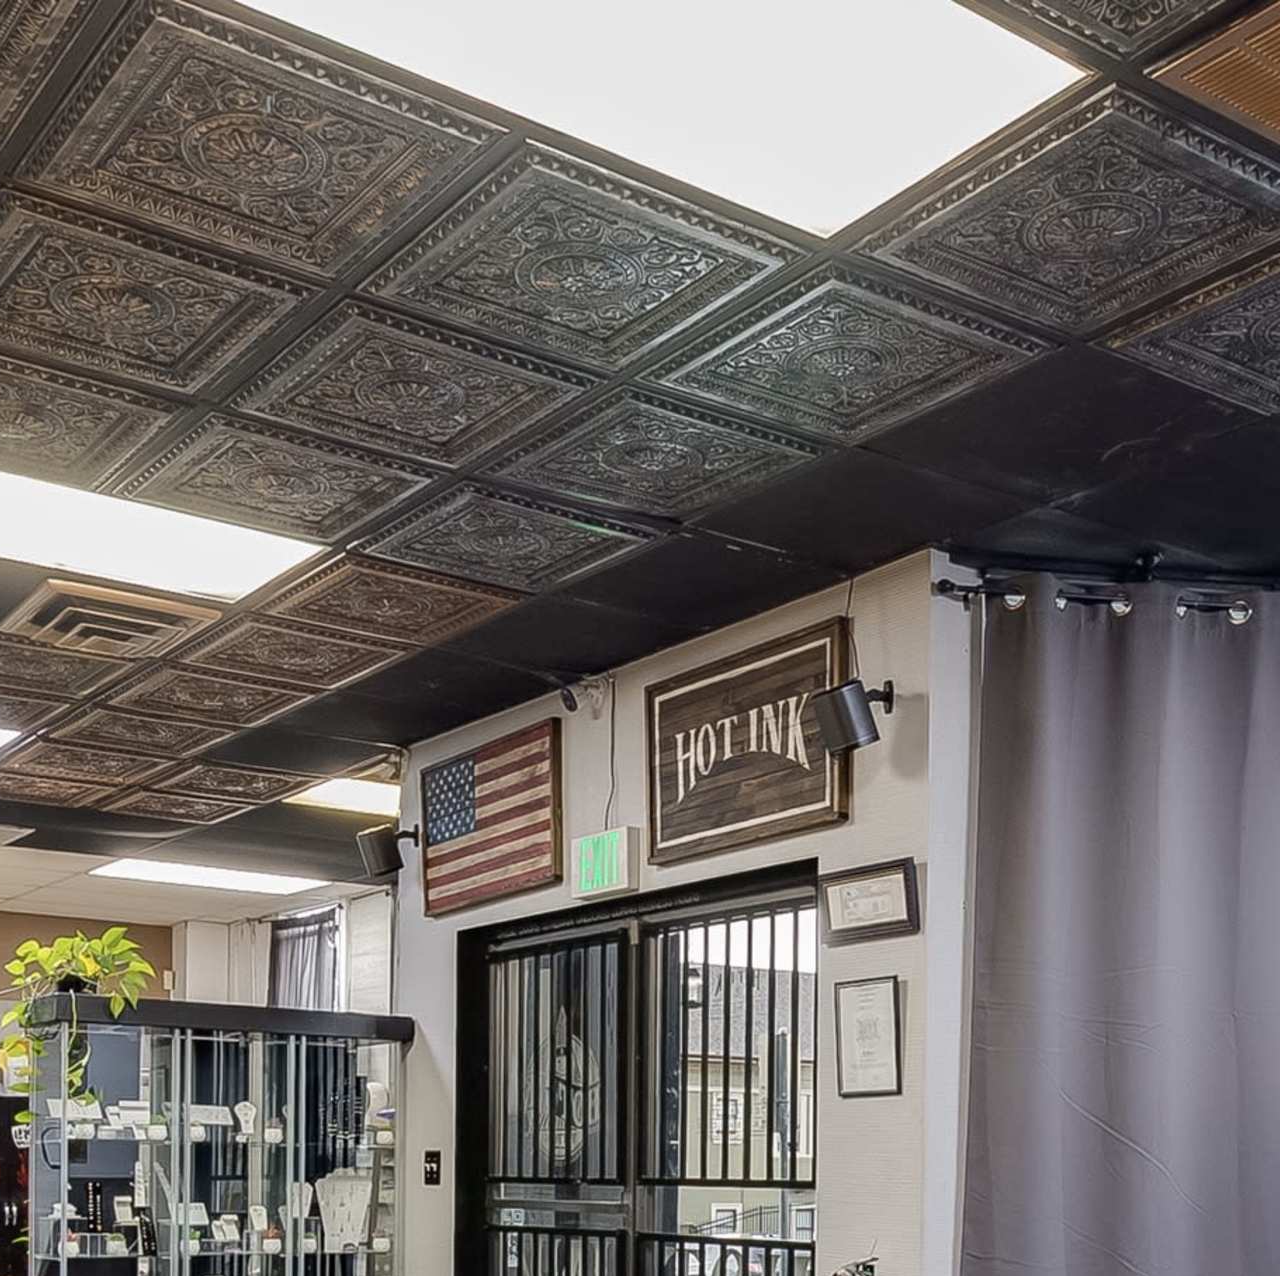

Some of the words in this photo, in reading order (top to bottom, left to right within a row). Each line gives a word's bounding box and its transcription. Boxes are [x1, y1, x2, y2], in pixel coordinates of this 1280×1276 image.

[675, 716, 738, 804] HOT
[744, 692, 811, 772] INK
[579, 831, 619, 892] EXIT
